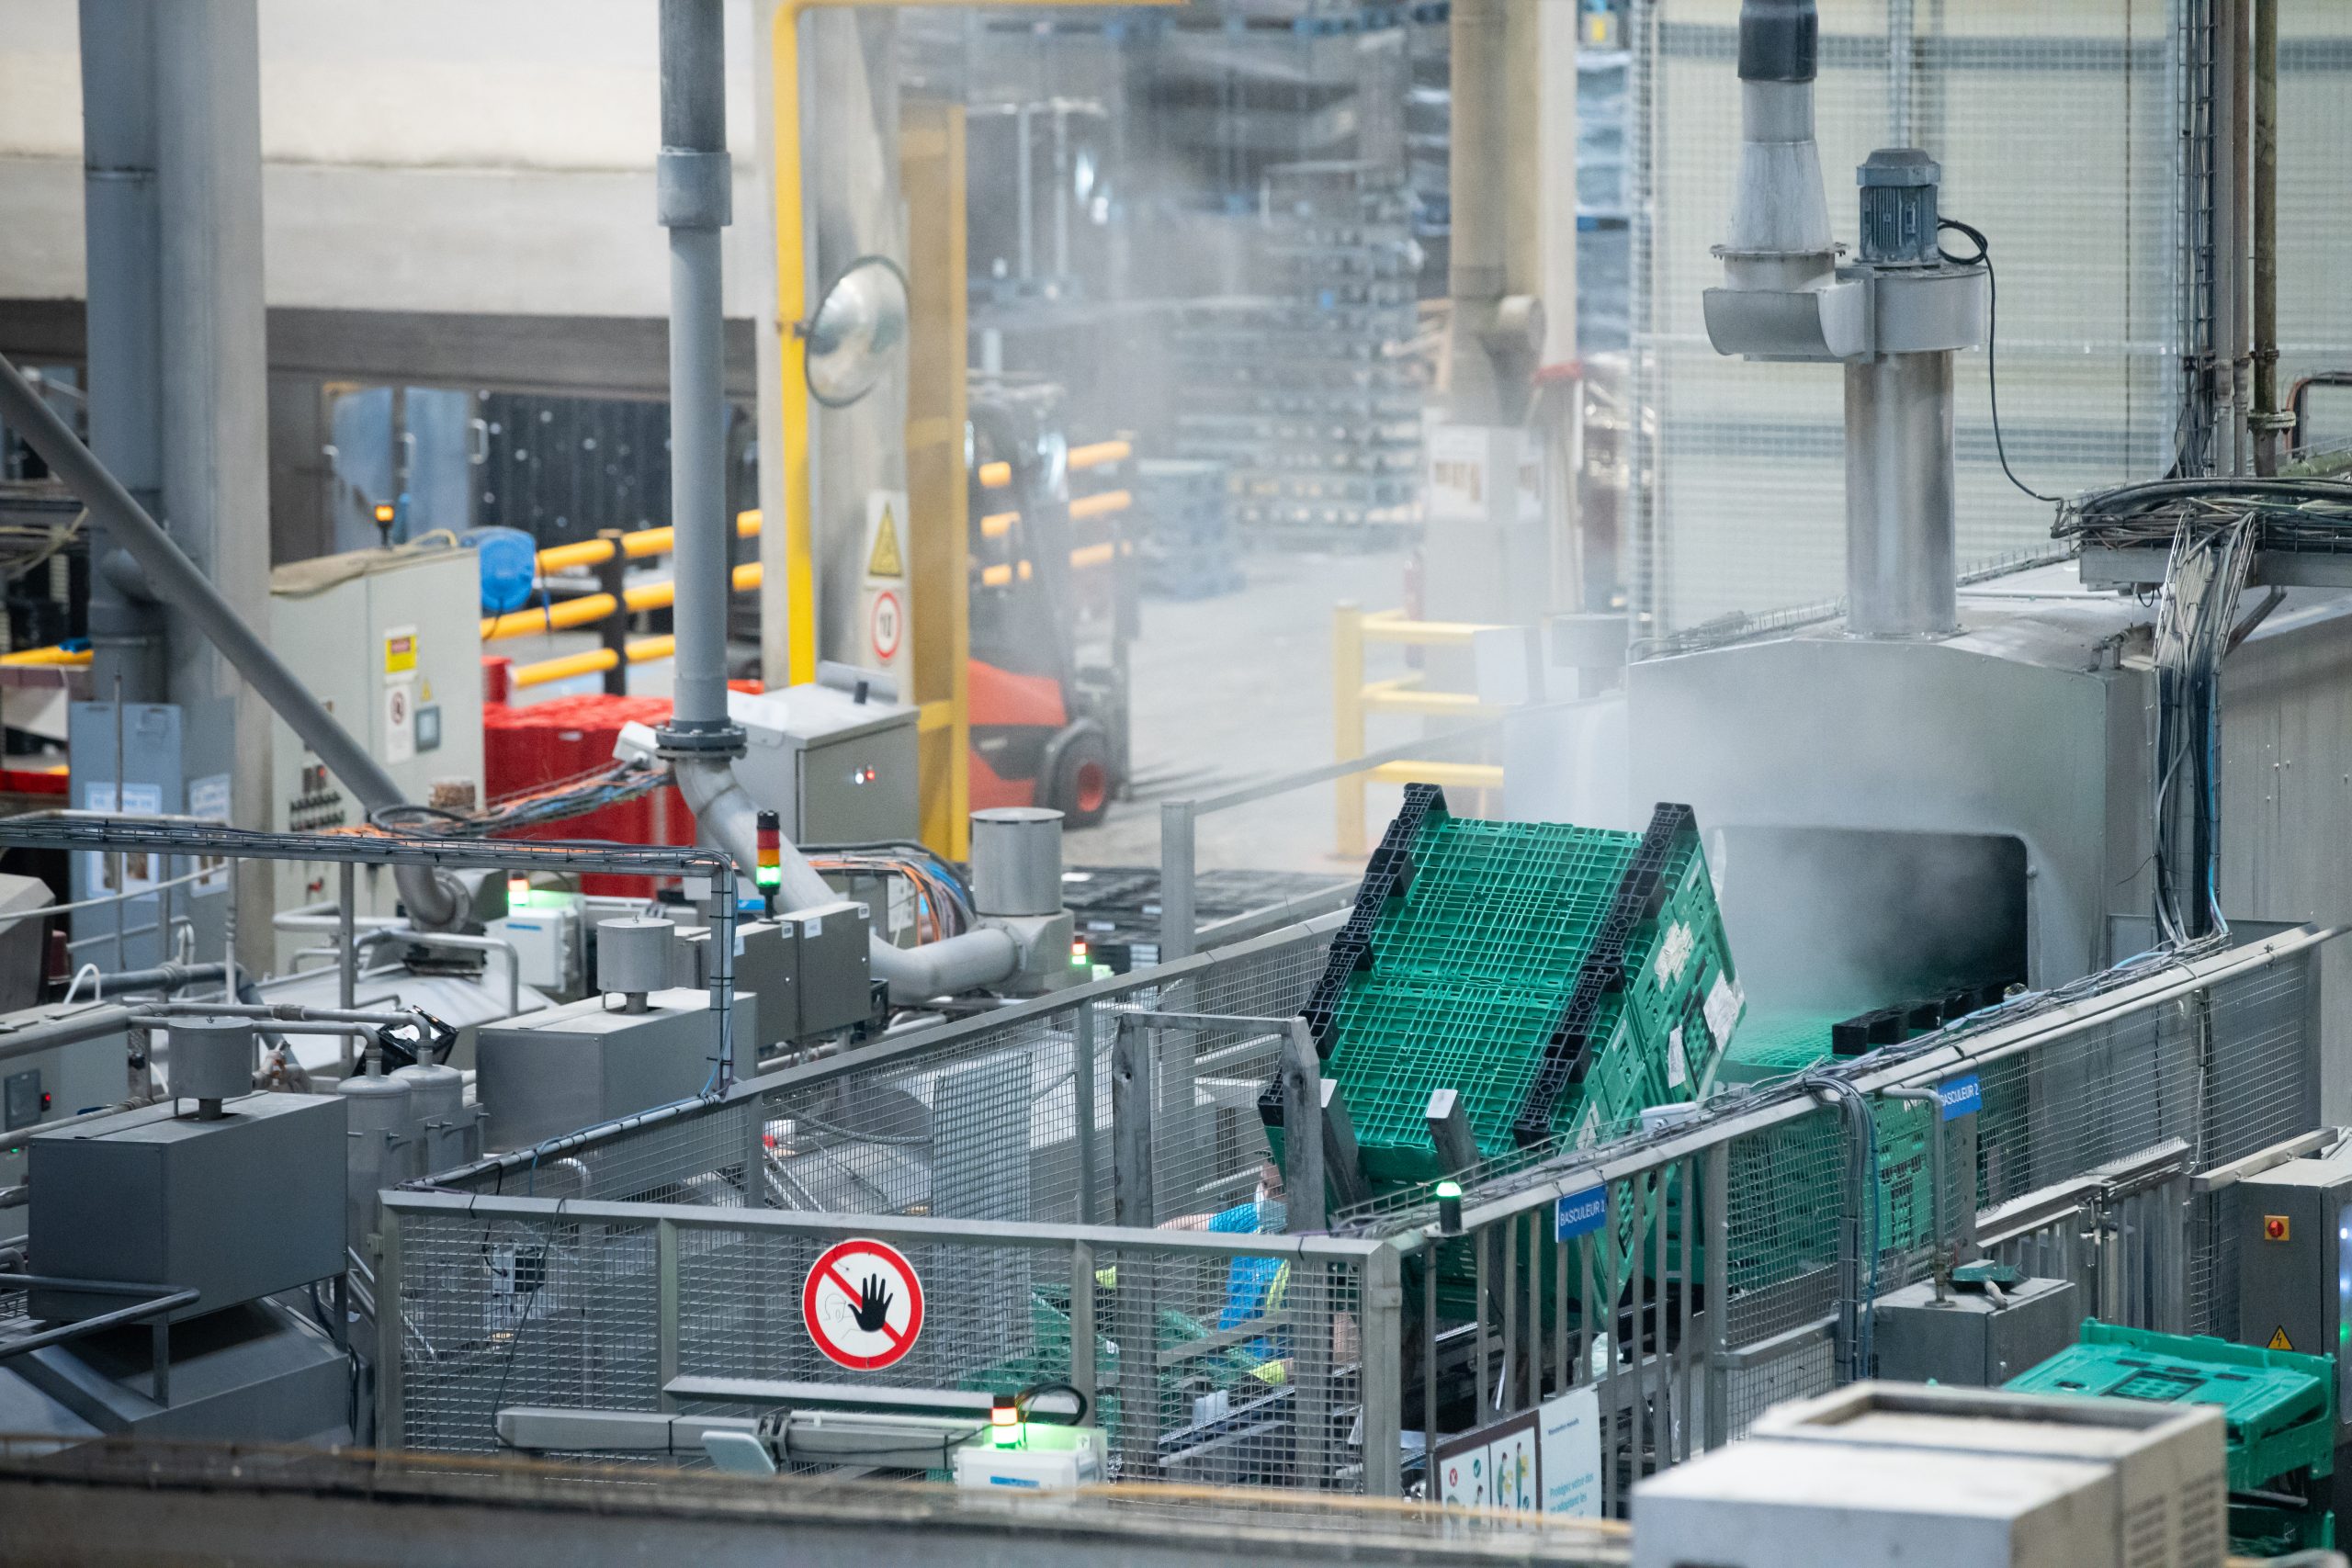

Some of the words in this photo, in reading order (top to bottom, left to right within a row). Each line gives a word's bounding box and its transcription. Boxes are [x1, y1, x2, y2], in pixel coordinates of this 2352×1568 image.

[1973, 1083, 1980, 1096] 2
[1560, 1201, 1600, 1227] BASCULEUR
[1600, 1199, 1605, 1213] 1
